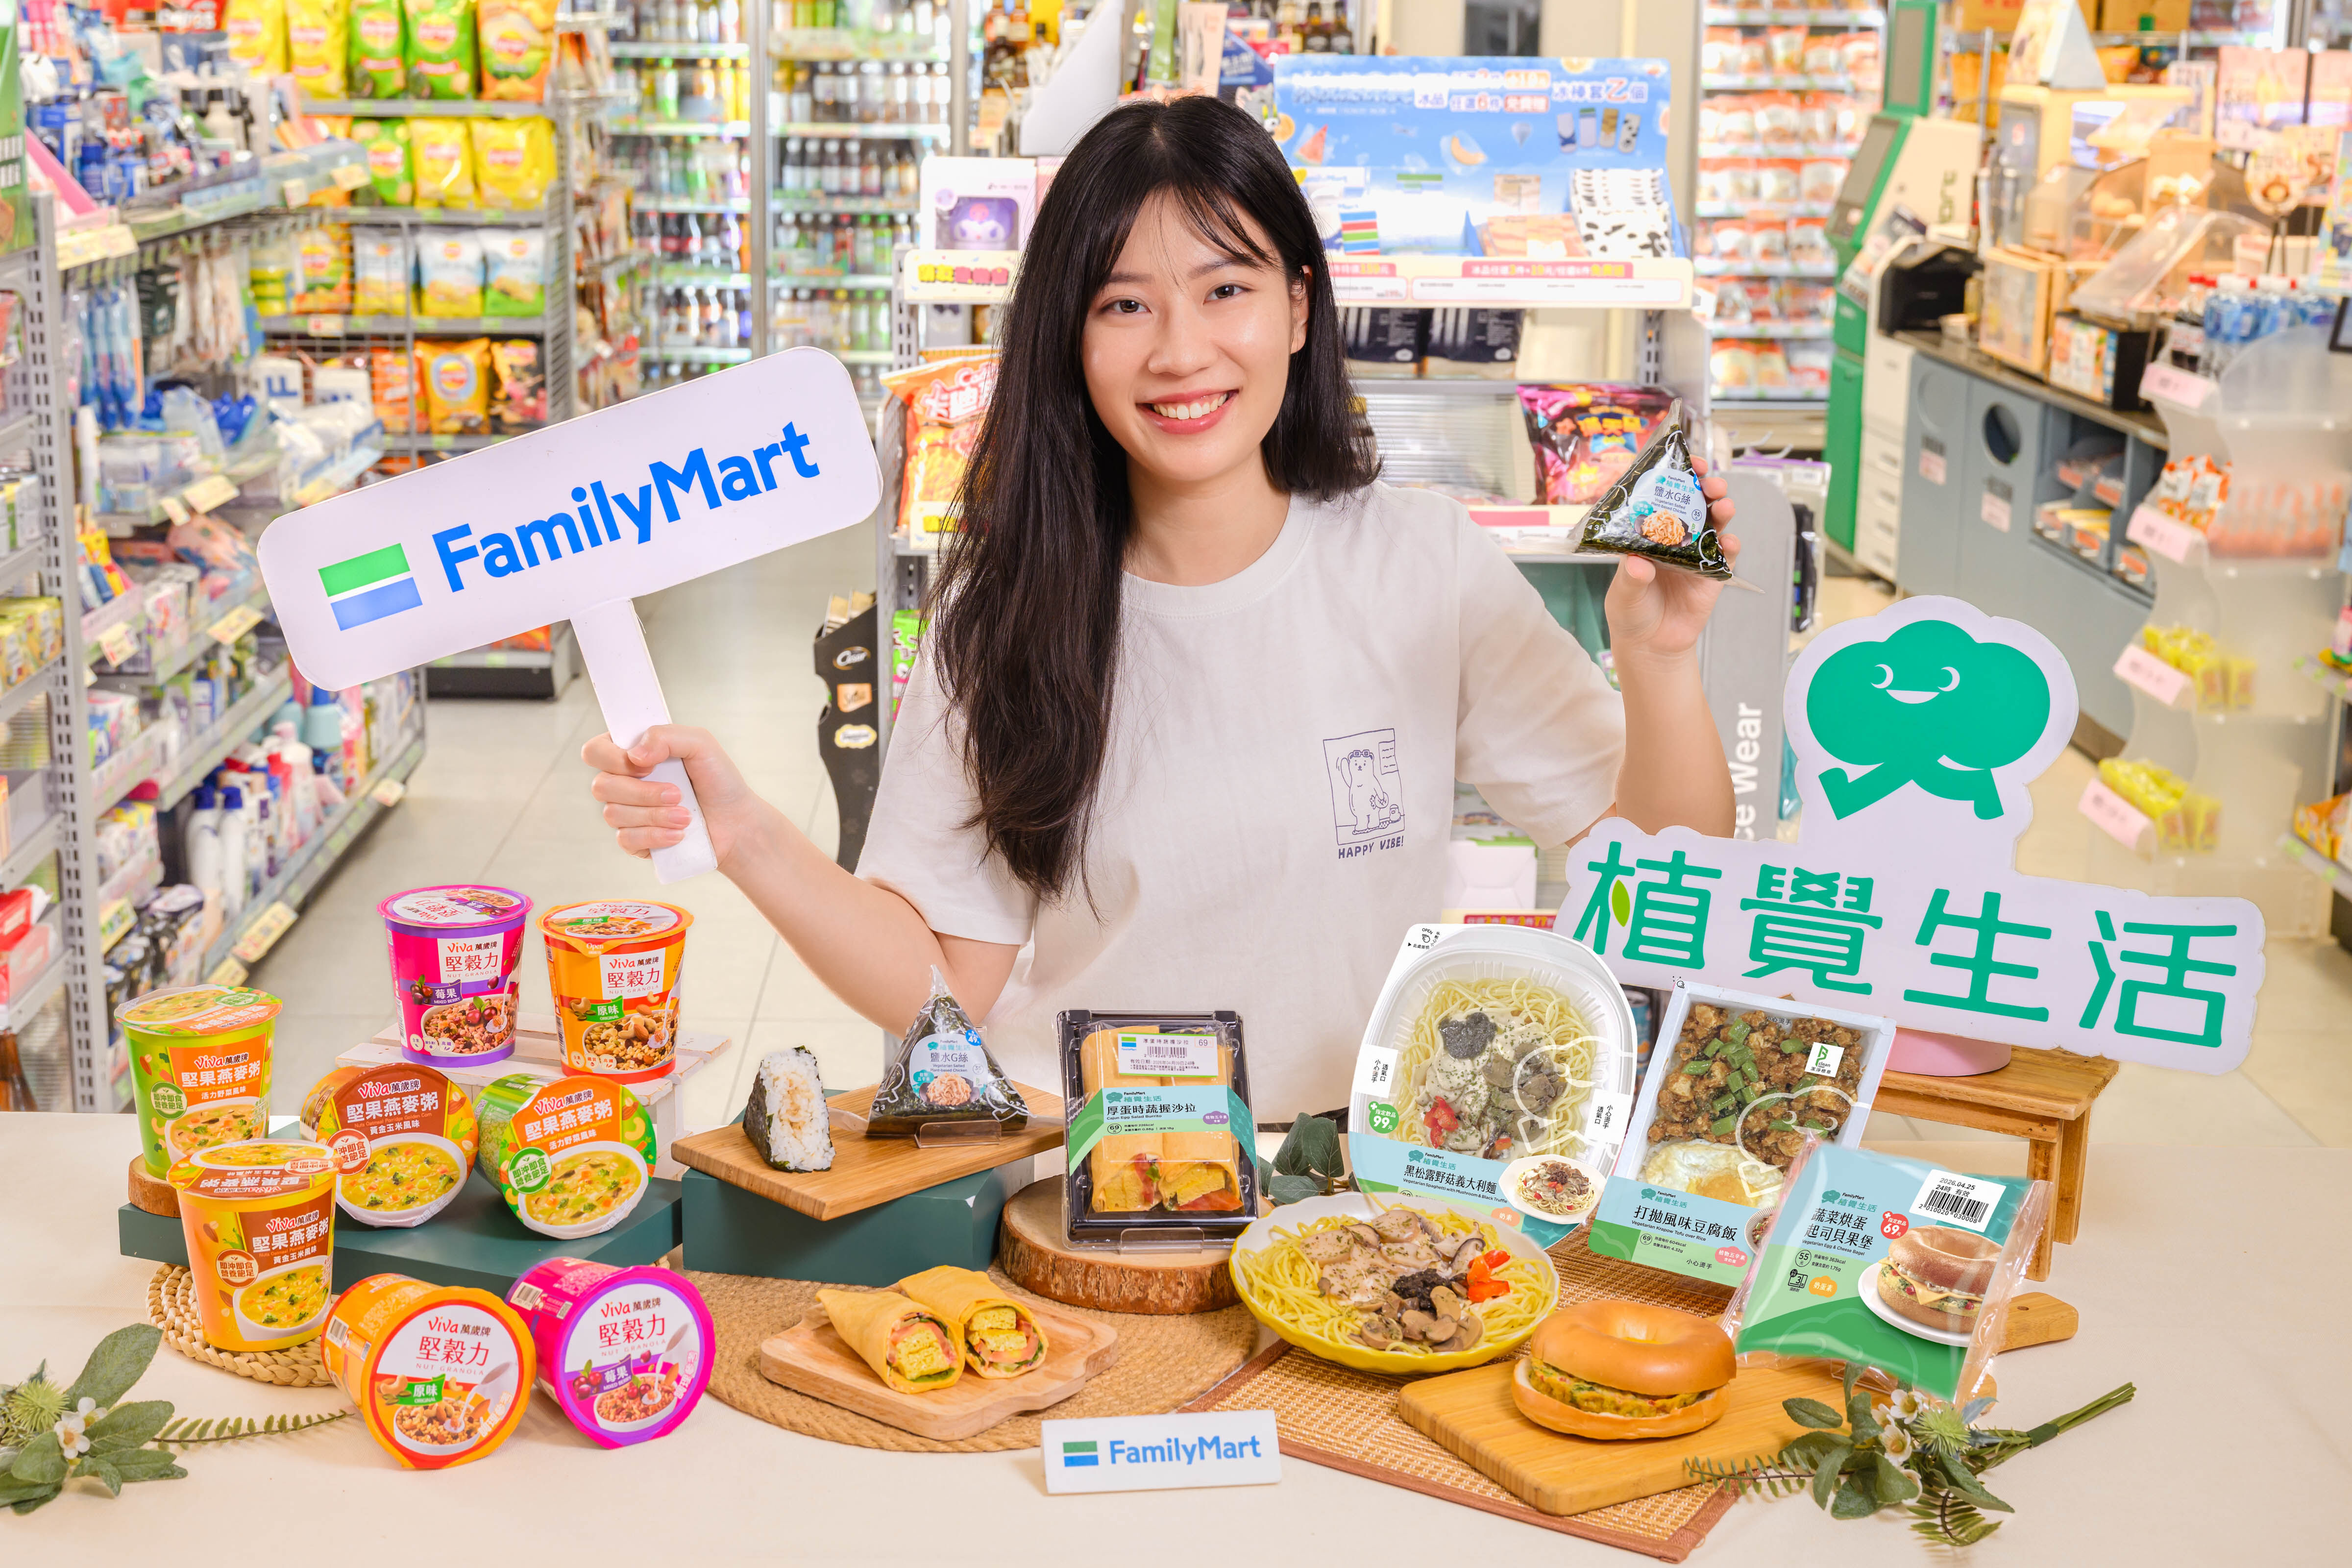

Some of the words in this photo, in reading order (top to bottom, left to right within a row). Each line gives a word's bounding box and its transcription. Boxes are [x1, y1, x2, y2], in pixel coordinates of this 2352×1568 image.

[1654, 486, 1691, 505] 鹽水G絲
[1655, 498, 1674, 507] Vegetarian
[432, 421, 820, 592] FamilyMart
[1651, 502, 1672, 512] Plant-based
[1728, 703, 1763, 794] Wear
[1339, 842, 1374, 858] HAPPY
[1380, 835, 1404, 850] VIBE!
[475, 941, 497, 951] 萬歲牌
[1572, 841, 2238, 1048] 植覺生活
[445, 952, 498, 972] 堅穀力
[637, 956, 659, 967] 萬歲牌
[607, 968, 660, 988] 堅穀力
[435, 988, 457, 999] 莓果
[627, 985, 659, 993] GRANOLA
[597, 1004, 619, 1016] 原味
[1765, 1016, 1791, 1025] 小心燙手
[225, 1053, 248, 1065] 萬歲牌
[931, 1053, 968, 1063] 鹽水G絲
[181, 1060, 261, 1088] 堅果燕麥粥
[1372, 1059, 1381, 1083] 小心燙手
[1380, 1063, 1389, 1082] 透氣口
[392, 1079, 420, 1092] 萬歲牌
[153, 1094, 182, 1102] 即沖即食
[201, 1086, 246, 1100] 活力野菜風味
[565, 1089, 593, 1105] 萬歲牌
[154, 1101, 183, 1110] 營養飽足
[346, 1092, 439, 1123] 堅果燕麥粥
[1107, 1103, 1196, 1116] 厚蛋時蔬握沙拉
[1375, 1108, 1396, 1118] 指定飲品
[1594, 1106, 1604, 1125] 透氣口
[1603, 1105, 1613, 1129] 小心燙手
[370, 1121, 420, 1135] 黃金玉米風味
[525, 1100, 612, 1142] 堅果燕麥粥
[549, 1129, 596, 1150] 活力野菜風味
[513, 1157, 546, 1178] 即沖即食
[1423, 1158, 1456, 1170] 植覺生活
[1404, 1165, 1497, 1194] 黑松露野菇義大利麵
[1939, 1177, 1975, 1190] 2026.04.25
[1403, 1178, 1425, 1186] Vegetarian
[1456, 1189, 1477, 1197] Mushroom
[1956, 1189, 1970, 1197] 有效
[1838, 1198, 1878, 1213] 植覺生活
[297, 1210, 319, 1225] 萬歲牌
[1499, 1212, 1512, 1222] 奶素
[1811, 1207, 1868, 1231] 蔬菜烘蛋
[1888, 1218, 1906, 1226] 指定飲品
[1926, 1206, 1949, 1215] 010020
[1954, 1213, 1978, 1224] 030008
[1632, 1220, 1655, 1229] Vegetarian
[1656, 1226, 1674, 1234] Krapow
[1634, 1205, 1738, 1241] 打拋風味豆腐飯
[252, 1218, 328, 1253] 堅果燕麥粥
[1804, 1224, 1873, 1250] 起司貝果堡
[274, 1246, 317, 1265] 黃金玉米風味
[1718, 1250, 1745, 1261] 植物五辛素
[220, 1261, 253, 1270] 即沖即食
[1686, 1258, 1713, 1270] 小心燙手
[1814, 1282, 1832, 1292] 奶蛋素
[633, 1298, 661, 1312] 萬歲牌
[461, 1324, 491, 1337] 萬歲牌
[599, 1313, 665, 1348] 堅穀力
[416, 1335, 490, 1367] 堅穀力
[624, 1339, 666, 1353] GRANOLA
[440, 1366, 484, 1375] GRANOLA
[604, 1366, 628, 1383] 莓果
[413, 1383, 438, 1397] 原味
[603, 1382, 617, 1391] MIXED
[618, 1376, 632, 1387] BERRY
[1109, 1435, 1261, 1465] FamilyMart
